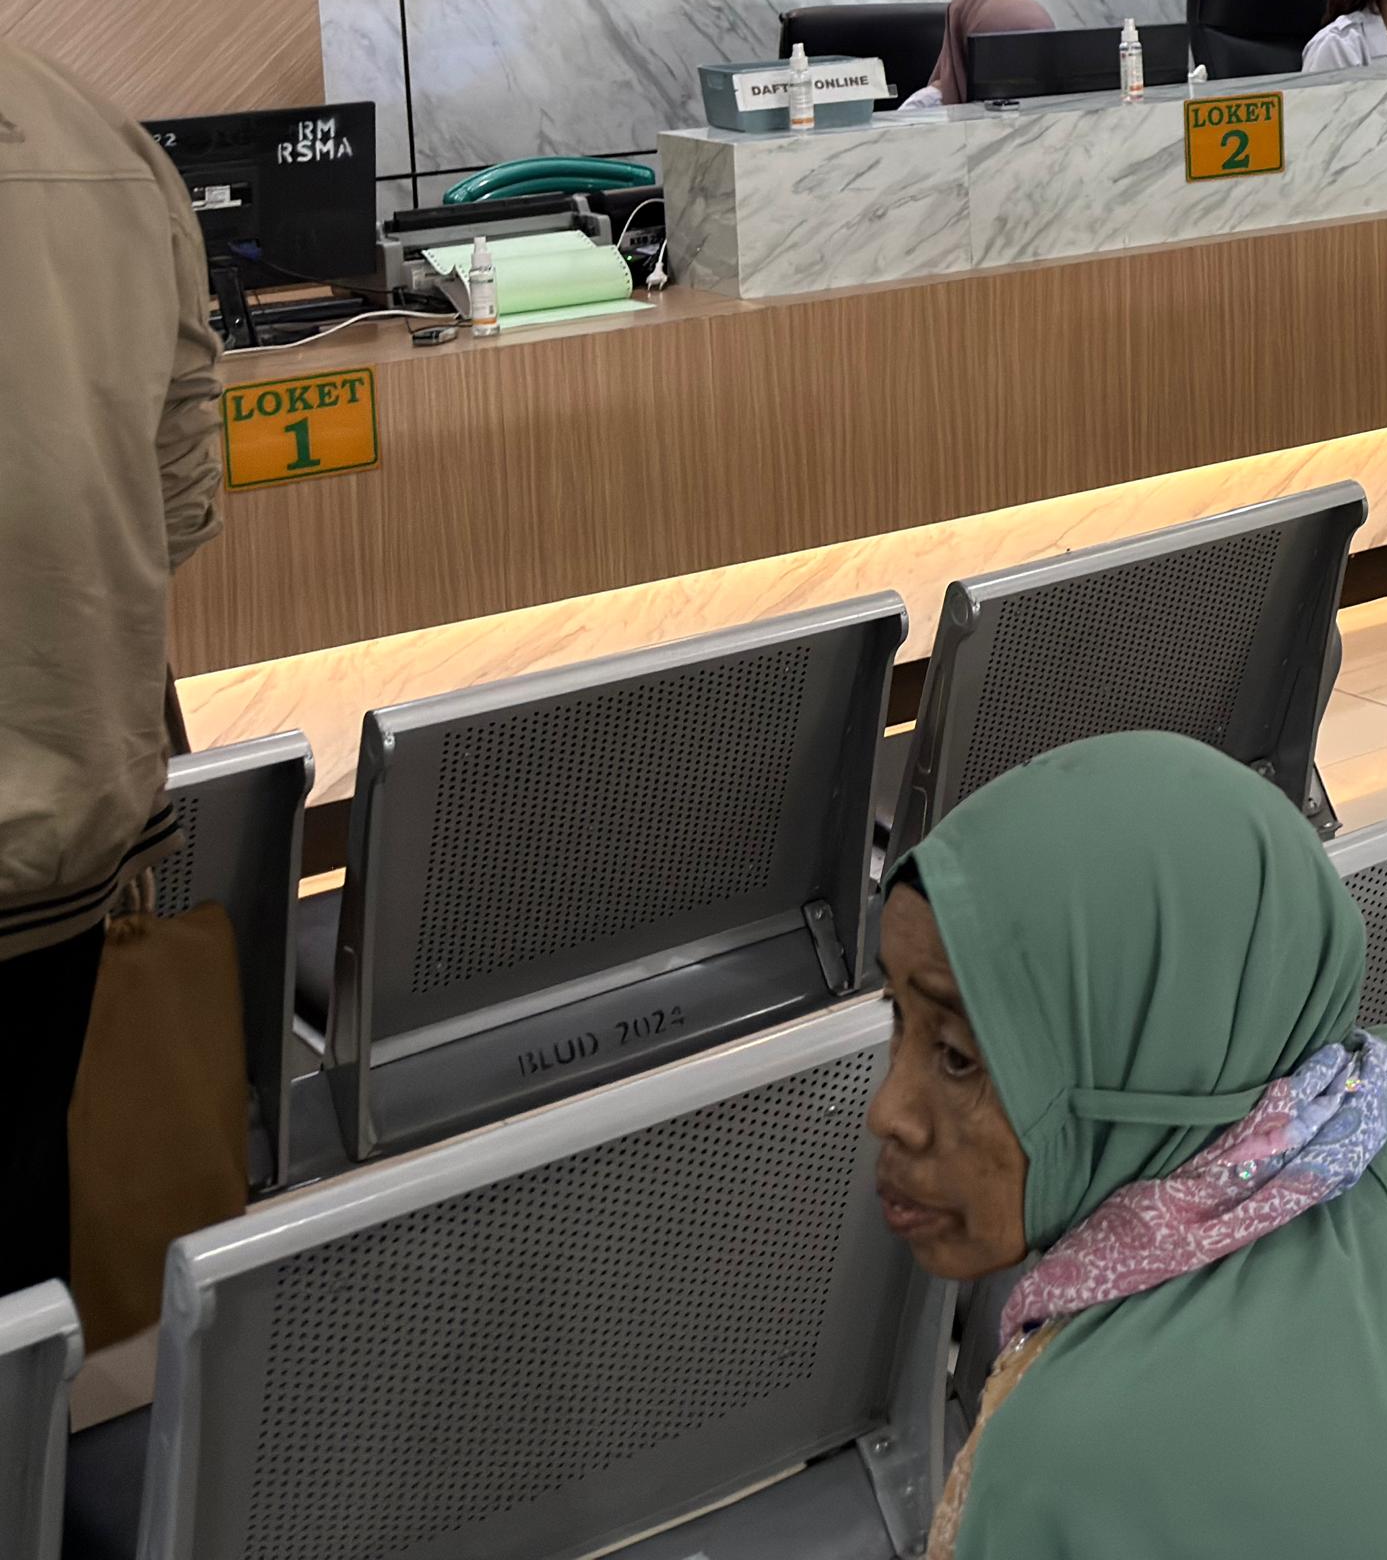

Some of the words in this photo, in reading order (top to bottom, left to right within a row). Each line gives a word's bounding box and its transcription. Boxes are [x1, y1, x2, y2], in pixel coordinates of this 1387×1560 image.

[751, 83, 794, 96] DAFT
[814, 75, 869, 90] ONLINE
[298, 117, 337, 141] RM
[1192, 101, 1275, 129] LOKET
[277, 137, 354, 165] RSMA
[1219, 129, 1251, 170] 2
[231, 377, 366, 423] LOKET
[282, 416, 322, 471] 1
[517, 1031, 600, 1078] BLUD
